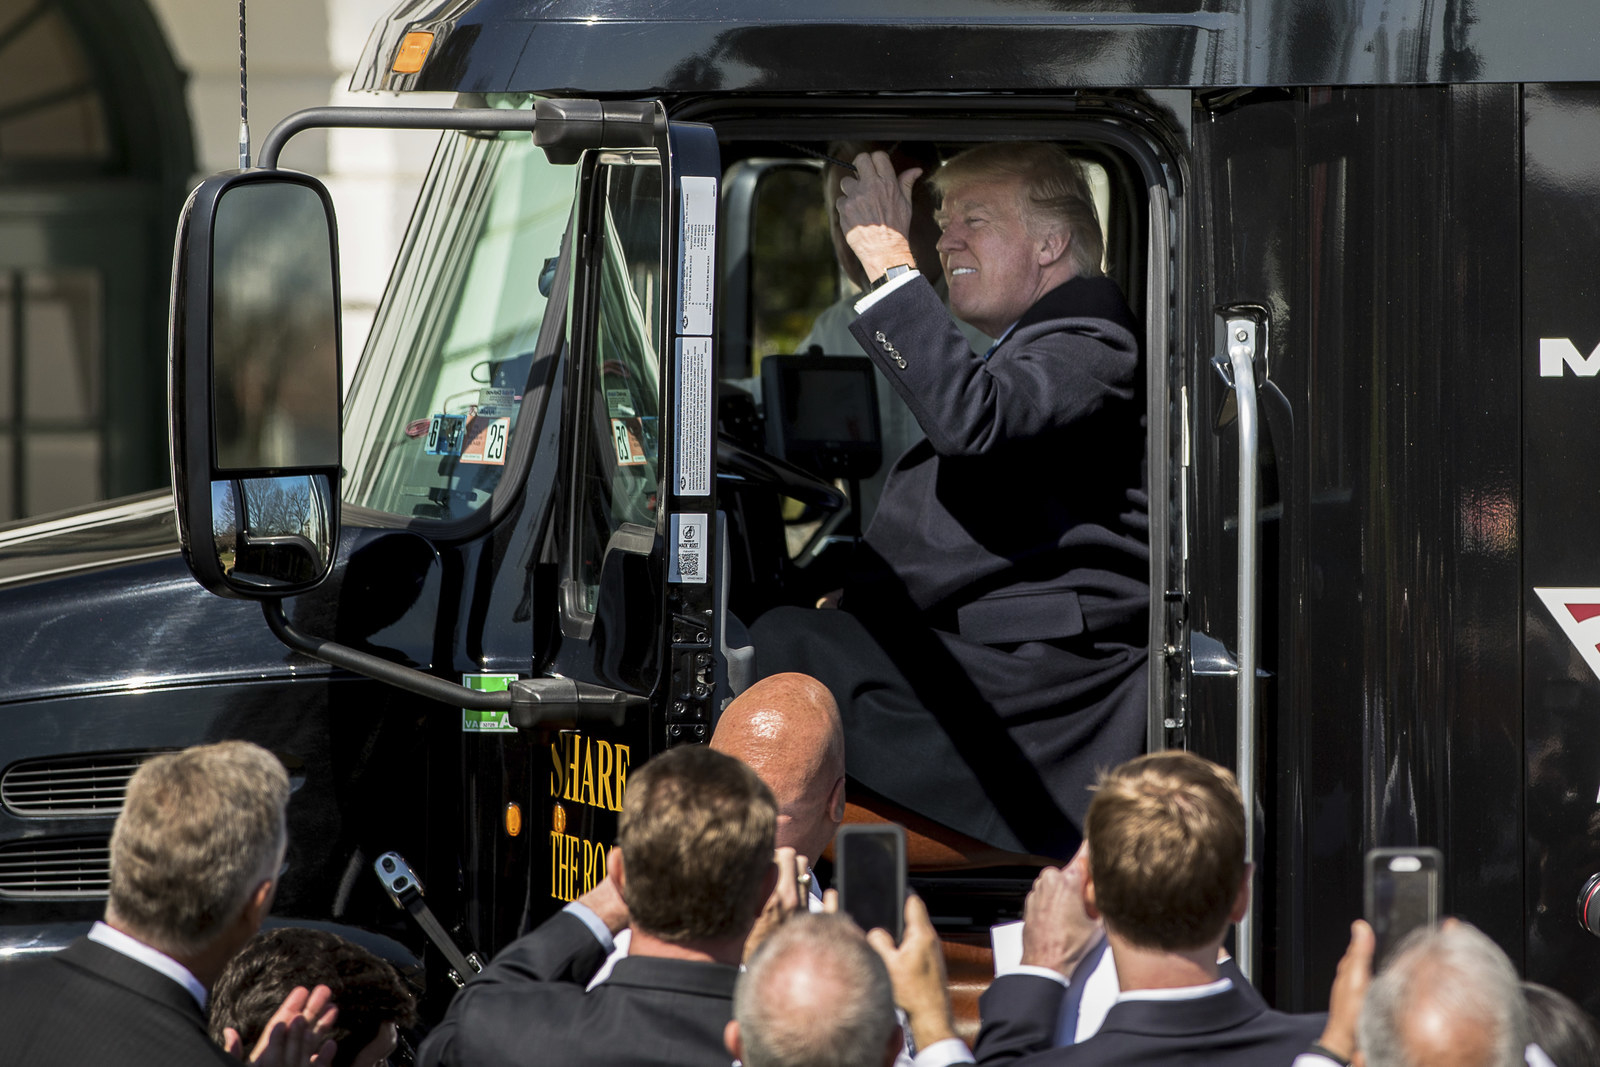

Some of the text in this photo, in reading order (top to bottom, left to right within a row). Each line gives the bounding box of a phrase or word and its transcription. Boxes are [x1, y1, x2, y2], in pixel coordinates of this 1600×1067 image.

[487, 424, 505, 459] 25
[465, 720, 479, 728] VA
[550, 731, 630, 812] SHARE
[549, 830, 580, 902] THE
